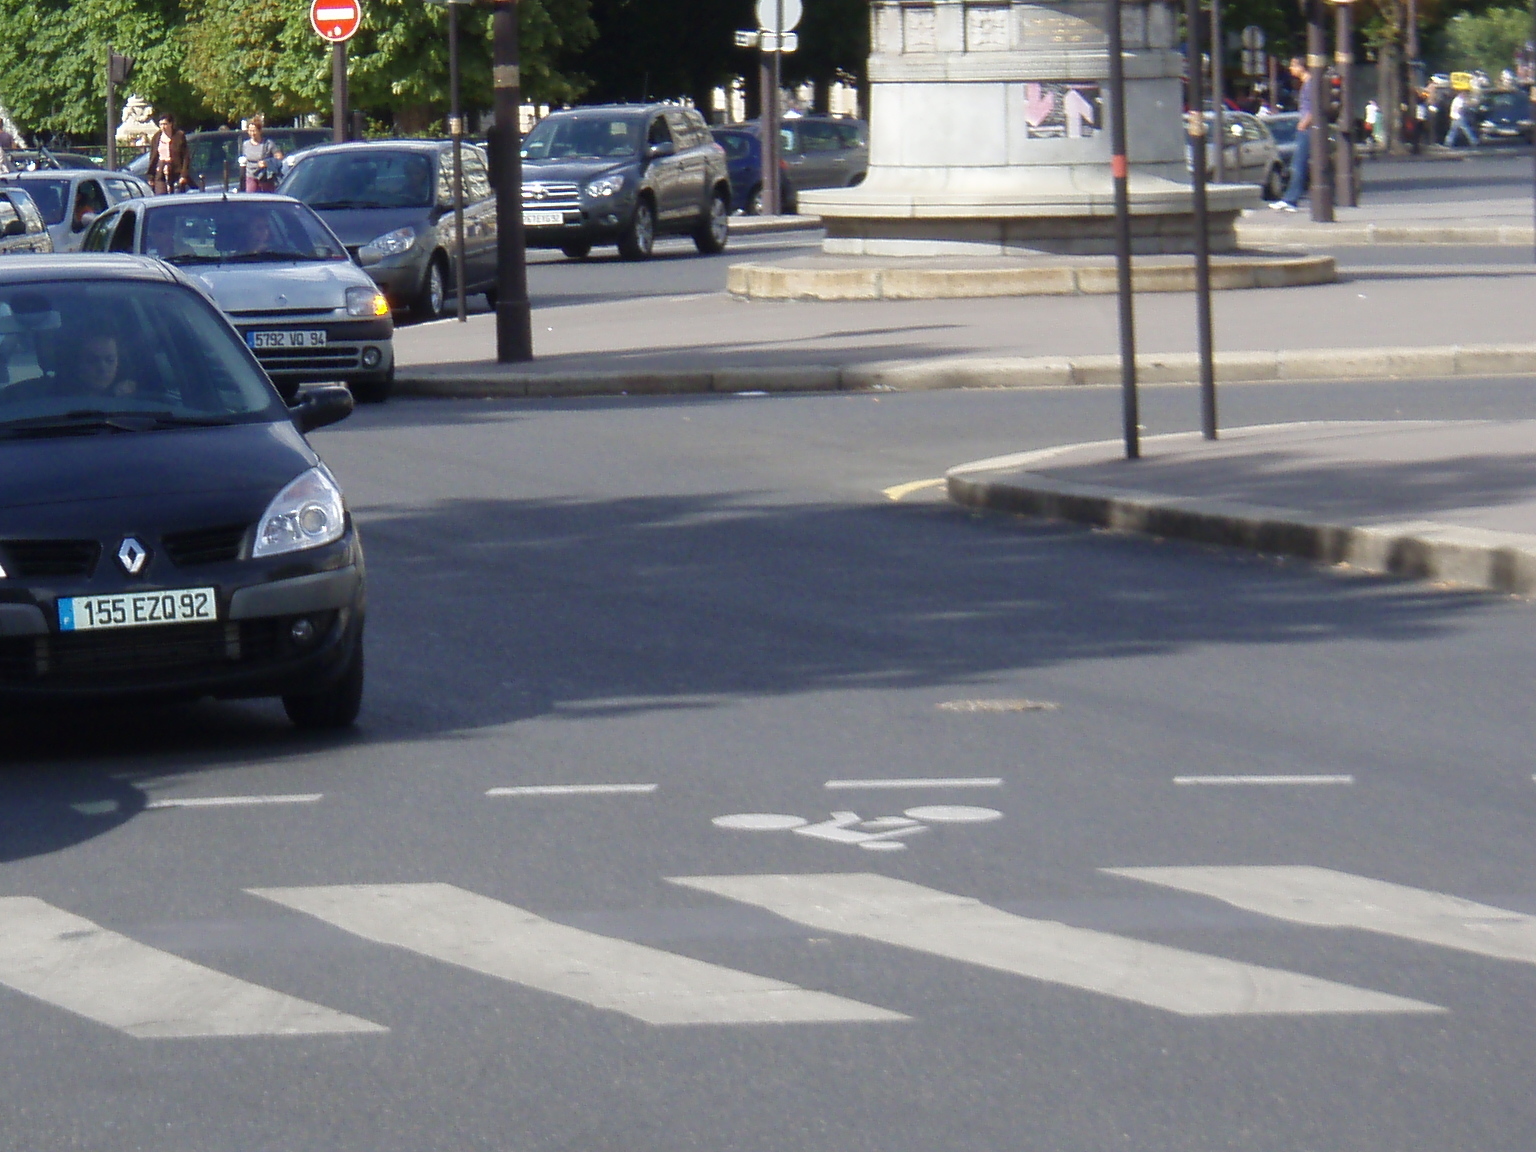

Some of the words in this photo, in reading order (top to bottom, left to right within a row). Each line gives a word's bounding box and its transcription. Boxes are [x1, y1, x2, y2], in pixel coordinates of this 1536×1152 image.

[255, 332, 284, 346] 5792
[310, 332, 324, 346] 94
[84, 599, 126, 625] 155
[133, 596, 176, 622] EZQ
[181, 593, 209, 618] 92
